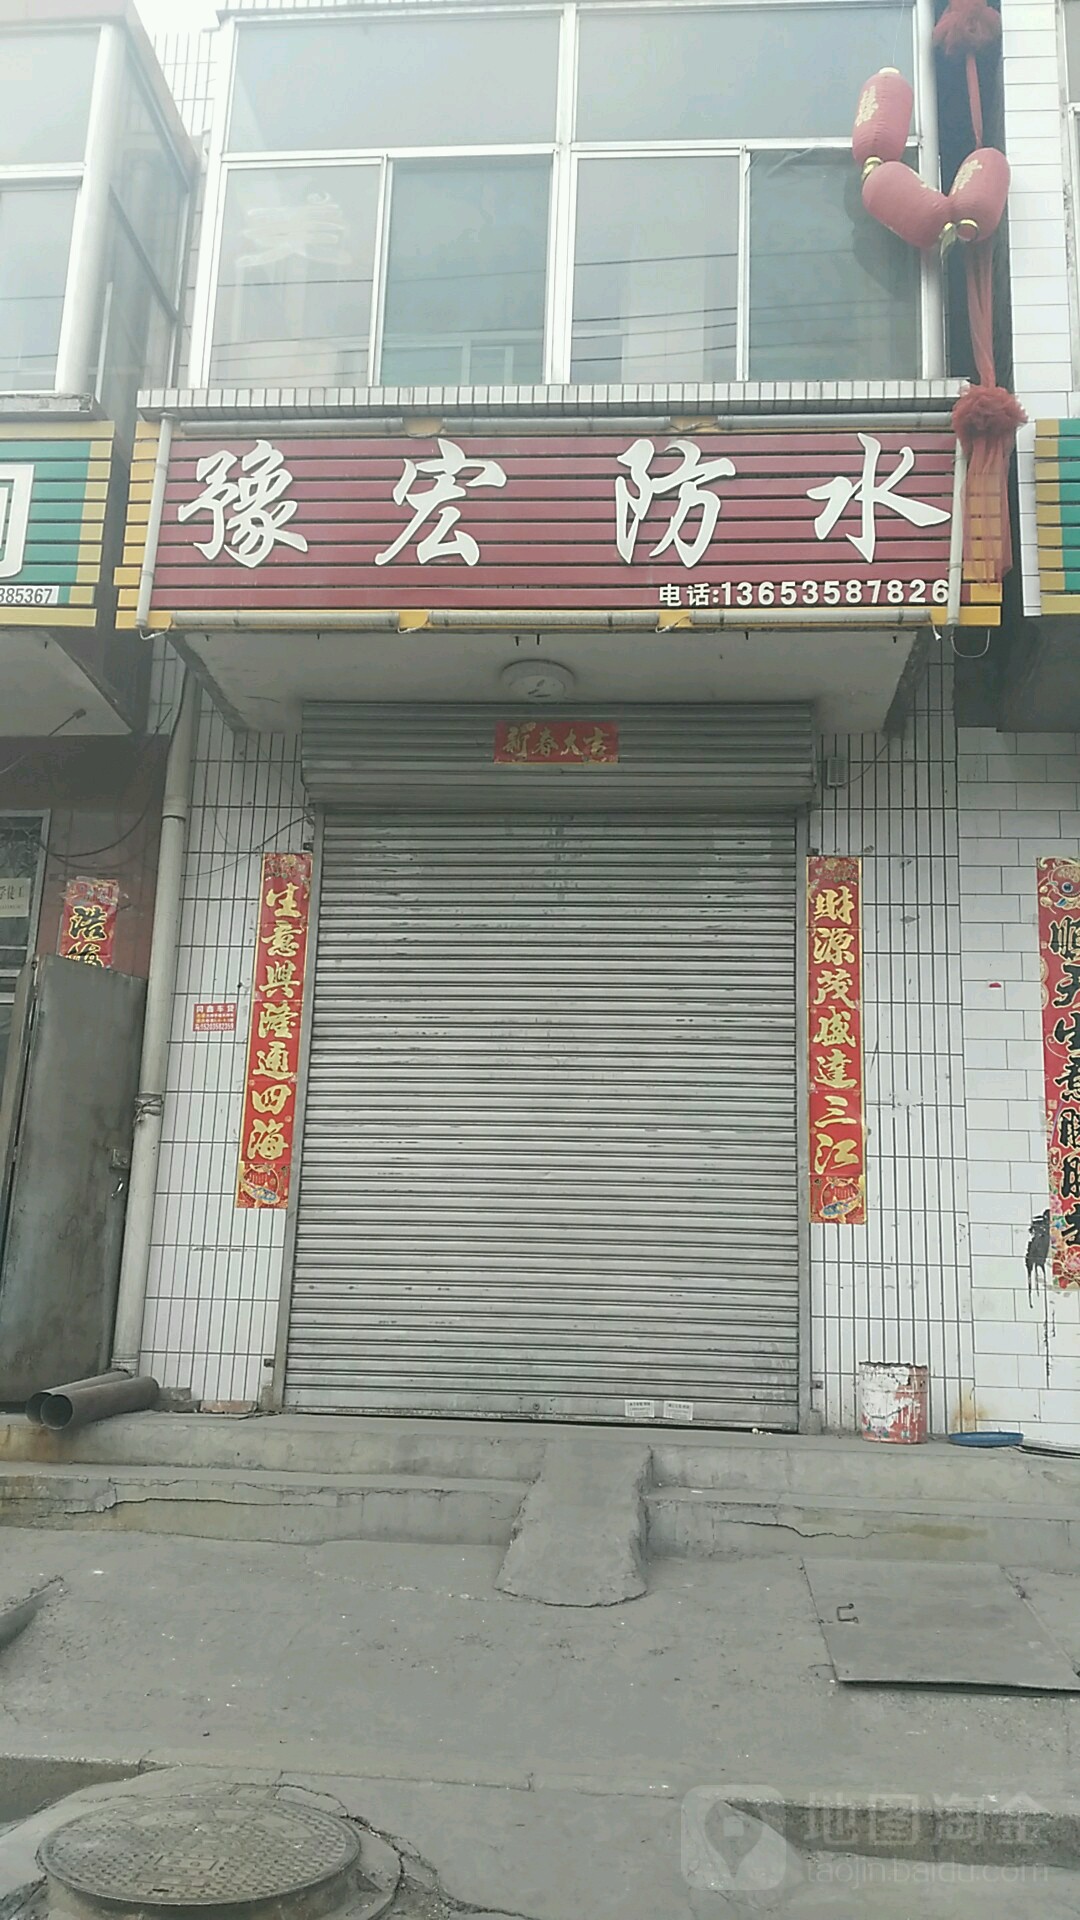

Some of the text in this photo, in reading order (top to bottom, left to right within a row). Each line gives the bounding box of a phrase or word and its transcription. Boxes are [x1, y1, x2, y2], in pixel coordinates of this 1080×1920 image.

[177, 432, 951, 568] 豫宏防水
[658, 578, 949, 606] 电话:13653587826
[502, 722, 610, 759] 新春大吉
